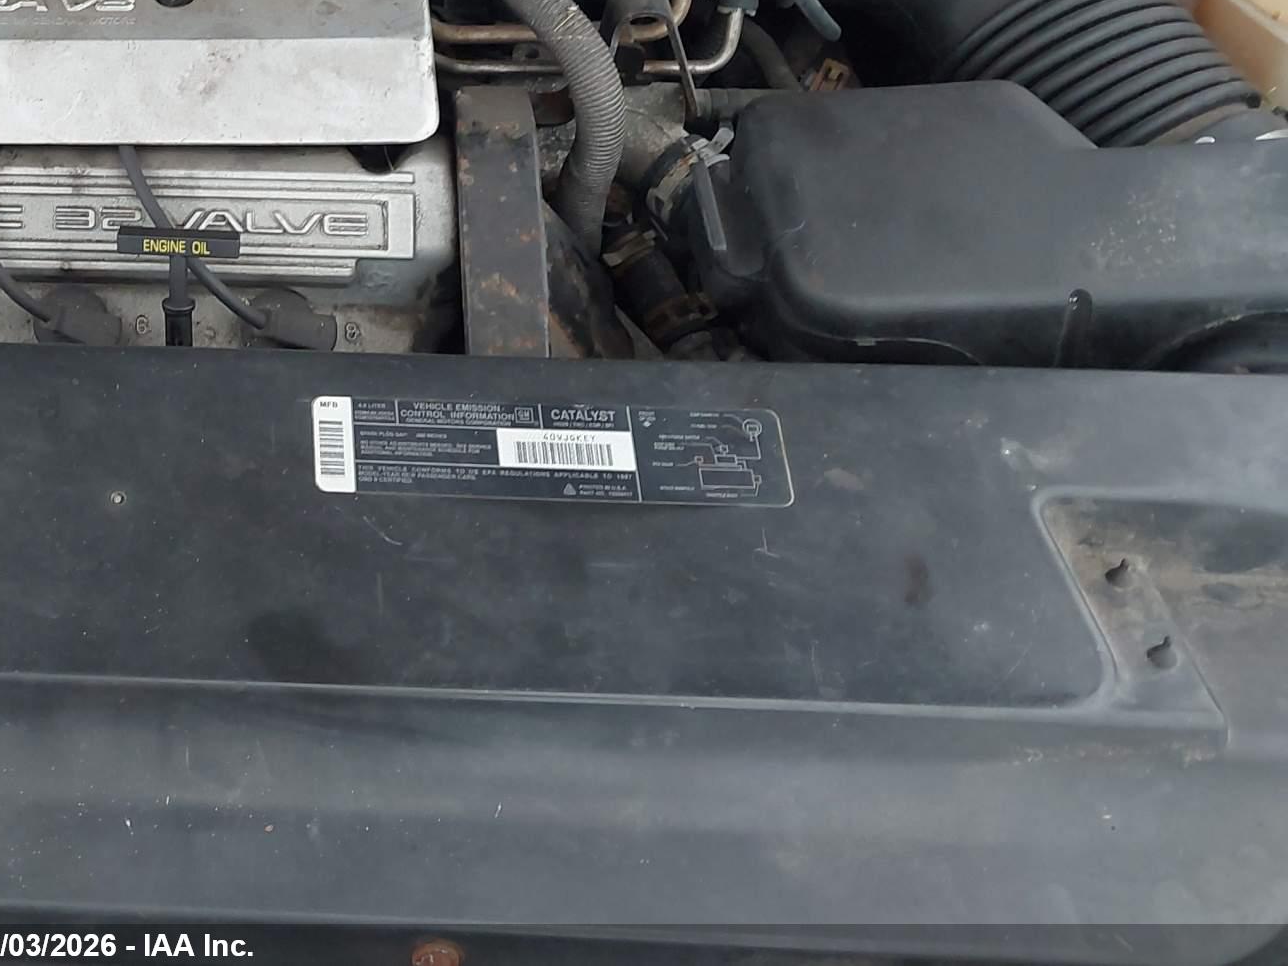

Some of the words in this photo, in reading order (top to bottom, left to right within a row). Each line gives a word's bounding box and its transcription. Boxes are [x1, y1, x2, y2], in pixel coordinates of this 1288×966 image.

[55, 205, 142, 230] 32
[143, 238, 186, 254] ENGINE
[192, 240, 210, 255] OIL
[136, 315, 151, 334] 6
[345, 322, 360, 340] 8
[400, 409, 446, 418] CONTROL
[450, 413, 515, 421] INFORMATION
[413, 402, 453, 410] VEHICLE
[455, 403, 500, 412] EMISSION
[551, 409, 616, 422] CATALYST
